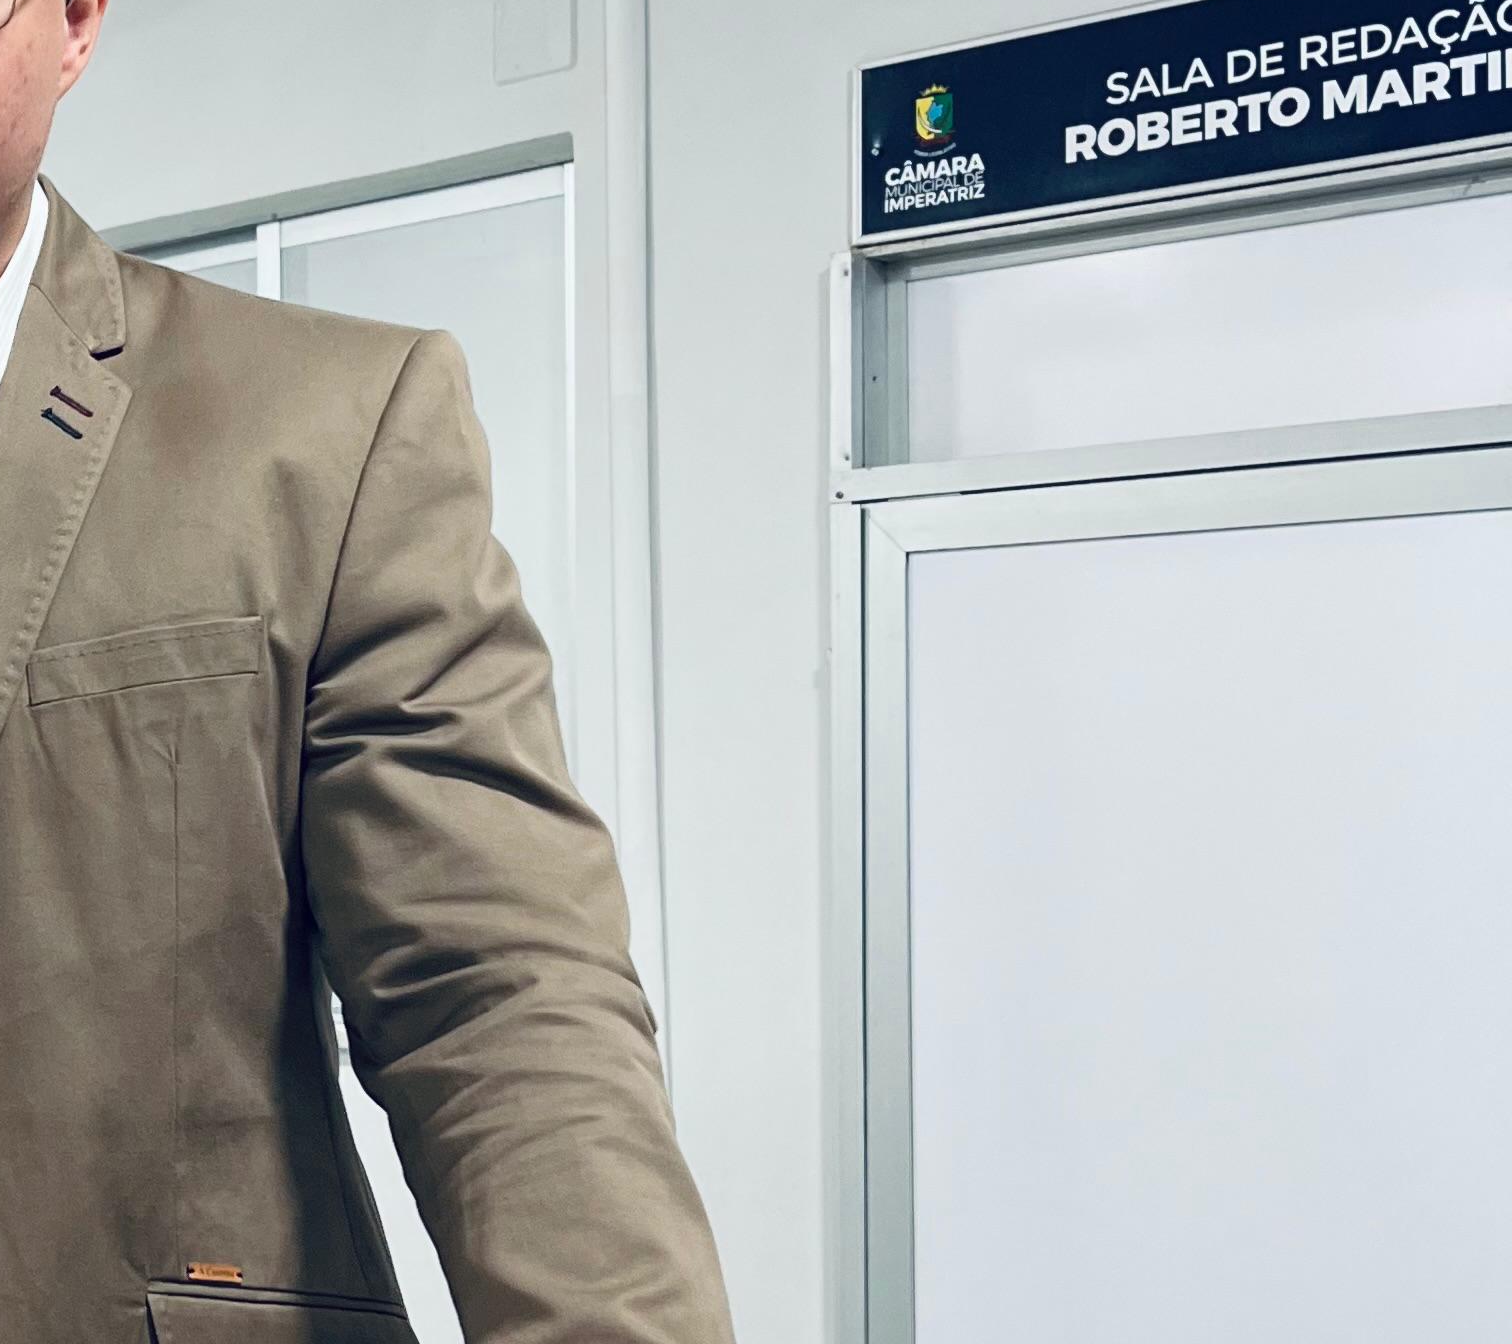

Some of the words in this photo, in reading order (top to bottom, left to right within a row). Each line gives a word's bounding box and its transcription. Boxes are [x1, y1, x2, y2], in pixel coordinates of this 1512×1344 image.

[1106, 58, 1214, 105] SALA
[1227, 42, 1285, 84] DE
[1065, 87, 1311, 164] ROBERTO
[1322, 47, 1512, 120] MARTI
[885, 153, 985, 186] CÂMARA
[885, 175, 960, 199] MUNICIPAL
[963, 171, 985, 187] DE
[884, 184, 985, 213] IMPERATRIZ
